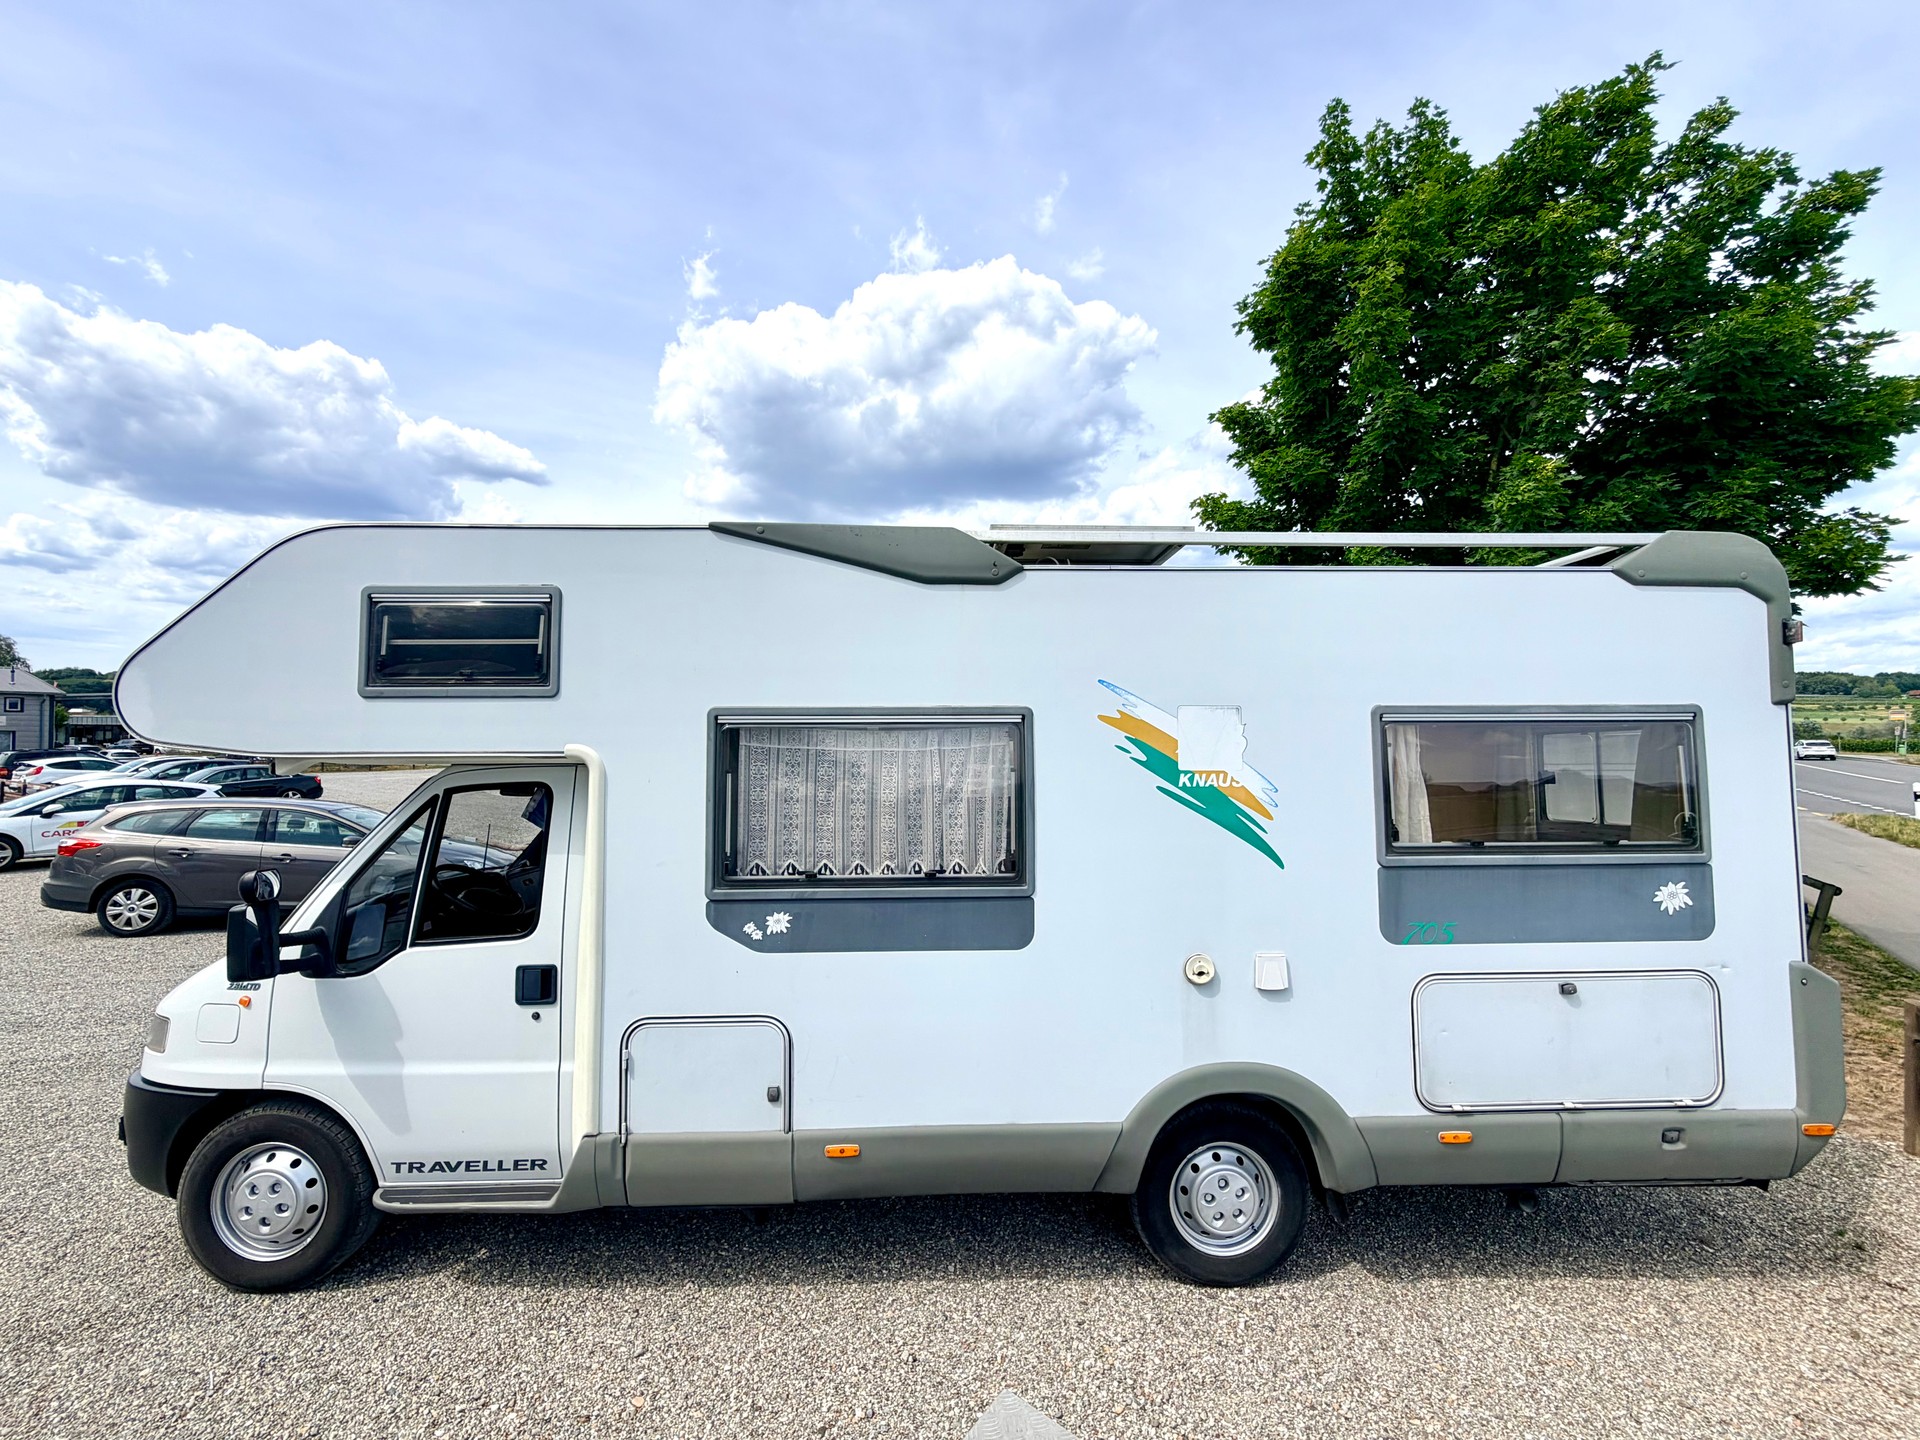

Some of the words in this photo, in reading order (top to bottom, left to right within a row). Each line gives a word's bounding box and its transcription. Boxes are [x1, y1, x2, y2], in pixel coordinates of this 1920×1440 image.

[1178, 773, 1242, 788] KNAUS
[1401, 922, 1457, 945] 705
[391, 1159, 548, 1174] TRAVELLER
